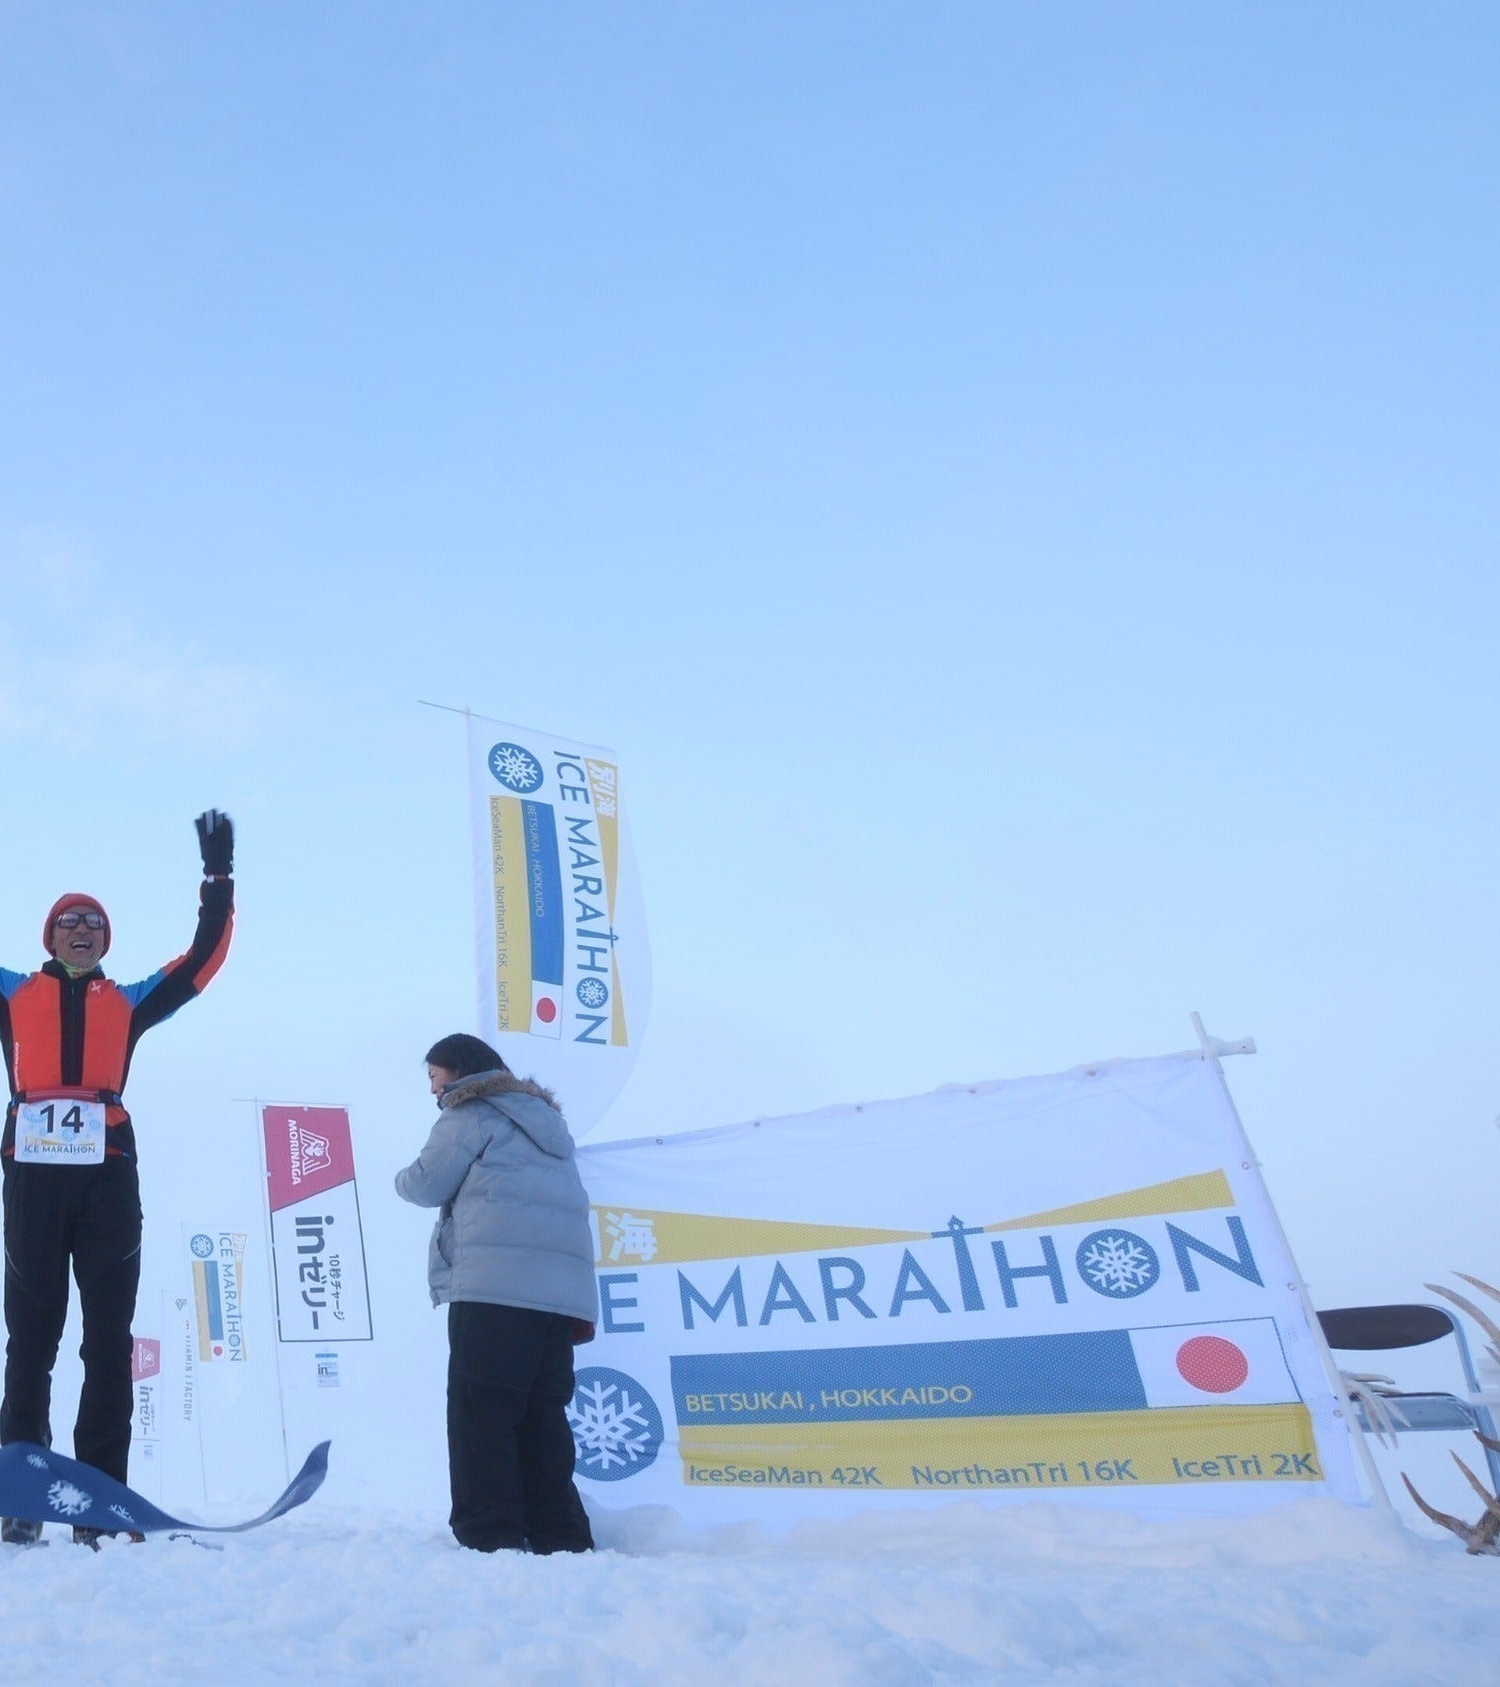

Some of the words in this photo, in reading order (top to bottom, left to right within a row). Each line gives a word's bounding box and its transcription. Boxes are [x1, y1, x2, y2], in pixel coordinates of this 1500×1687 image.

[553, 750, 590, 805] ICE
[492, 797, 503, 851] IceSeaMan
[494, 852, 505, 874] 42K
[533, 858, 545, 918] HOKKAIDO
[496, 885, 508, 944] NorthanTri
[564, 816, 616, 1045] MARATHON
[498, 948, 508, 968] 16K
[499, 981, 509, 1014] IceTri
[499, 1016, 509, 1030] 2K
[40, 1104, 84, 1133] 14
[25, 1145, 39, 1153] ICE
[43, 1144, 95, 1153] MARATHON
[288, 1119, 301, 1185] MORINAGA
[219, 1232, 233, 1257] ICE
[591, 1210, 657, 1262] 海
[295, 1215, 334, 1330] inゼリー
[329, 1254, 345, 1321] 10秒チャージ
[677, 1215, 1264, 1330] MARATHON
[222, 1264, 242, 1361] MARATHON
[317, 1363, 328, 1375] in
[183, 1381, 193, 1421] FACTORY
[821, 1385, 973, 1407] HOKKAIDO
[690, 1465, 822, 1485] IceSeaMan
[831, 1466, 882, 1485] 42K
[911, 1460, 1067, 1486] NorthanTri
[1078, 1459, 1138, 1482] 16K
[1171, 1455, 1262, 1478] IceTri
[1274, 1453, 1319, 1476] 2K
